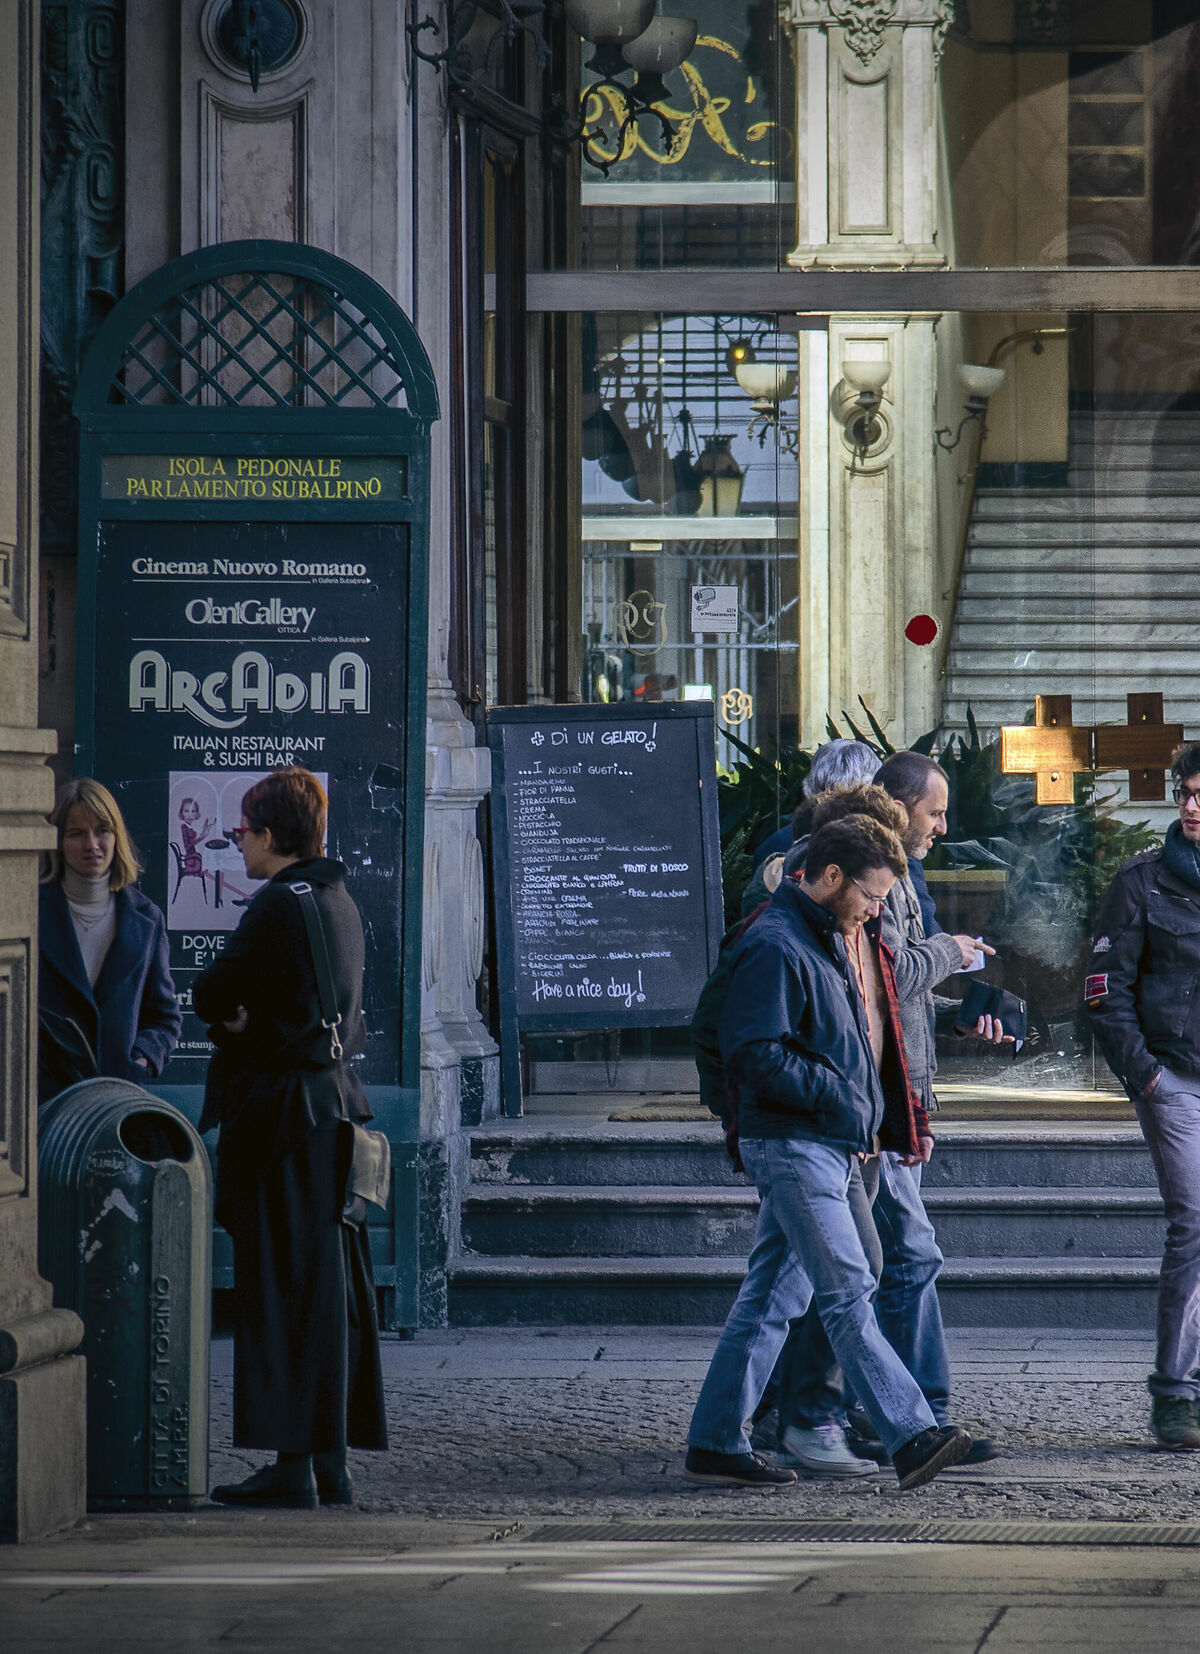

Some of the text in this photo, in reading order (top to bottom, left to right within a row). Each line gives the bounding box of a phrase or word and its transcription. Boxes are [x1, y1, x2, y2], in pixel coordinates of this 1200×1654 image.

[169, 457, 342, 477] ISOLA PEDONALE
[126, 478, 382, 498] PARLAMENTO SUBALPINO
[132, 558, 366, 576] Cinema Nuovo Romano
[318, 576, 339, 584] Galleria
[340, 576, 367, 585] Subalpina
[278, 626, 300, 634] OTTICA
[338, 636, 366, 644] Subalpina
[174, 736, 326, 750] ITALIAN RESTAURANT
[578, 731, 594, 744] UN
[204, 752, 294, 766] & SUSHI BAR
[520, 788, 537, 798] FIOR
[551, 786, 575, 794] PANNA
[520, 796, 577, 806] STRACCIATELLA
[520, 806, 547, 815] CREMA
[518, 813, 556, 822] NOCCIOLA
[518, 821, 562, 830] PISTACCHIO
[521, 838, 560, 846] CIOCCOLATO
[522, 855, 570, 864] STRACCIATELLA
[662, 862, 689, 872] BOSCO
[524, 874, 568, 883] CROCCANTE
[182, 935, 225, 950] DOVE
[532, 979, 562, 1002] Have
[565, 983, 575, 998] a
[577, 978, 603, 998] nice
[152, 1274, 171, 1370] TORINO
[152, 1380, 170, 1403] DI
